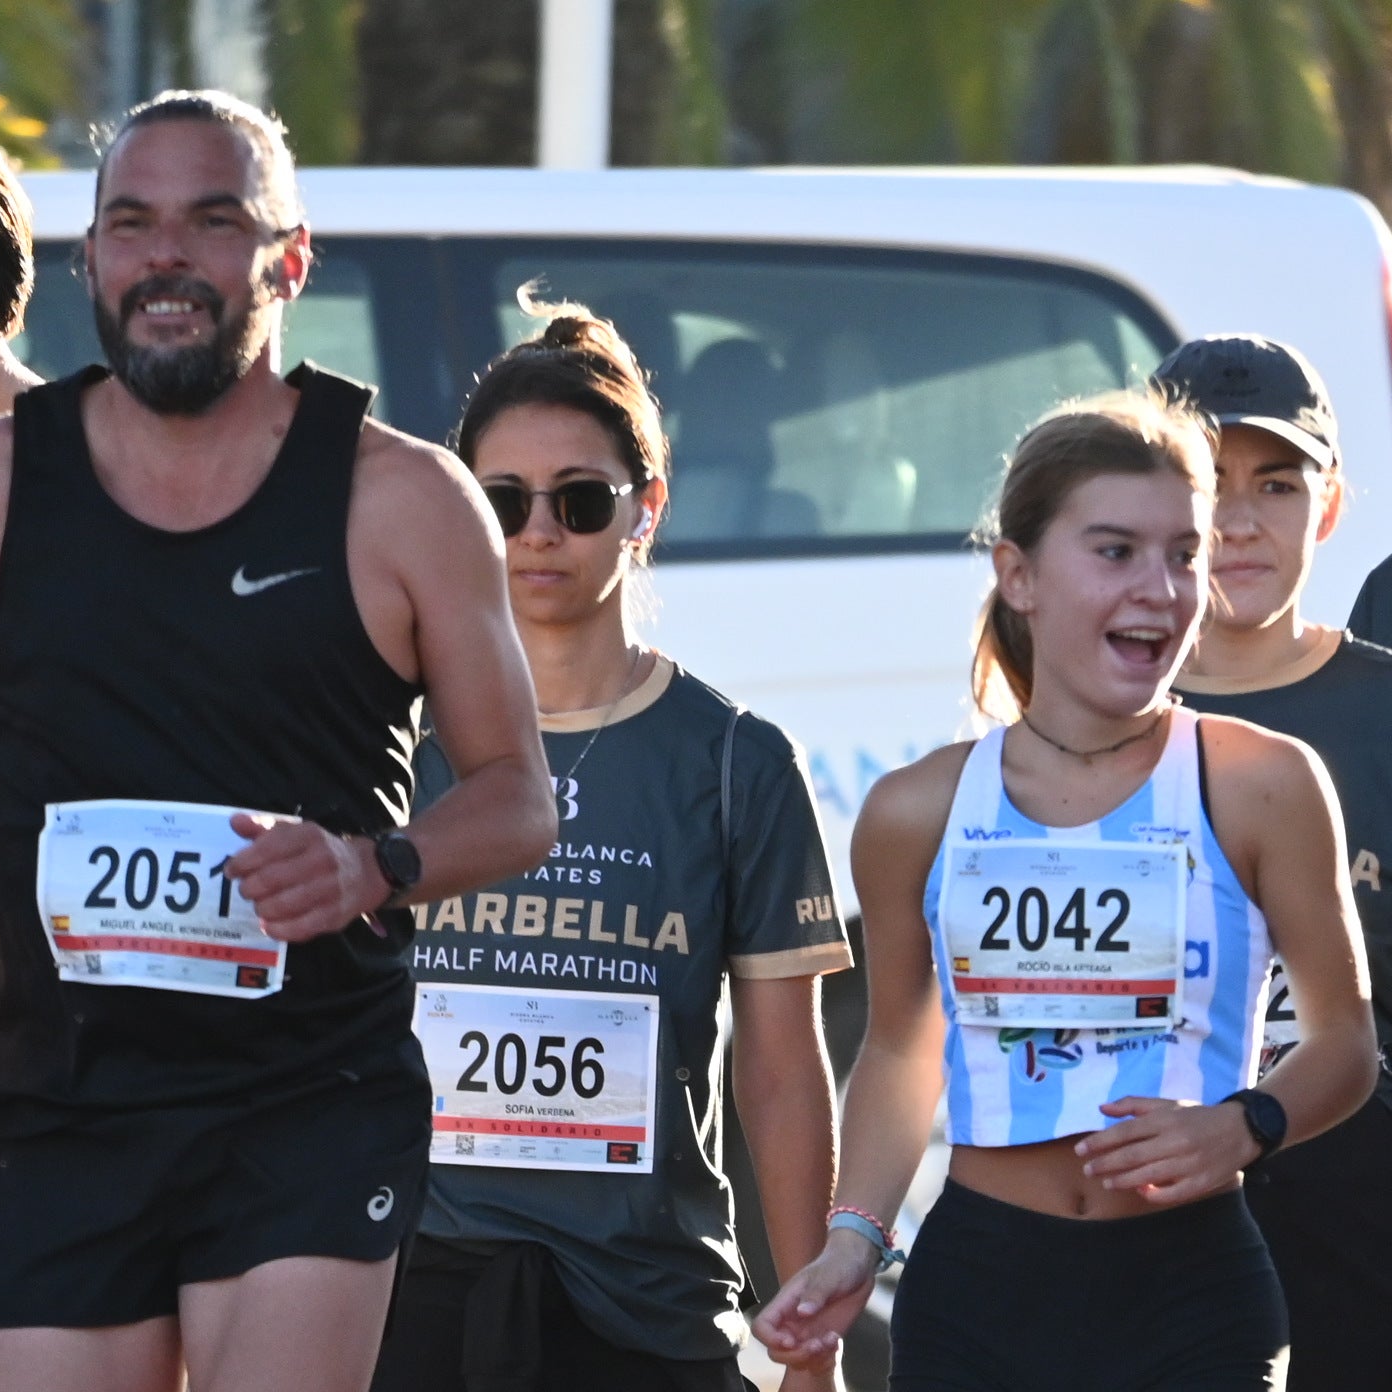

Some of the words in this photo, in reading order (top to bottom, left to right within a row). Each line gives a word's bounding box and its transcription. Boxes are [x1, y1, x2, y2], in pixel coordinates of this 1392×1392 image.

[549, 842, 653, 868] BLANCA
[84, 845, 233, 919] 2051
[523, 866, 603, 885] ATES
[99, 918, 136, 931] MIGUEL
[979, 886, 1131, 952] 2042
[412, 945, 485, 972] HALF
[494, 950, 658, 987] MARATHON
[455, 1030, 606, 1099] 2056
[504, 1103, 535, 1115] SOFIA
[537, 1107, 576, 1118] VERBENA
